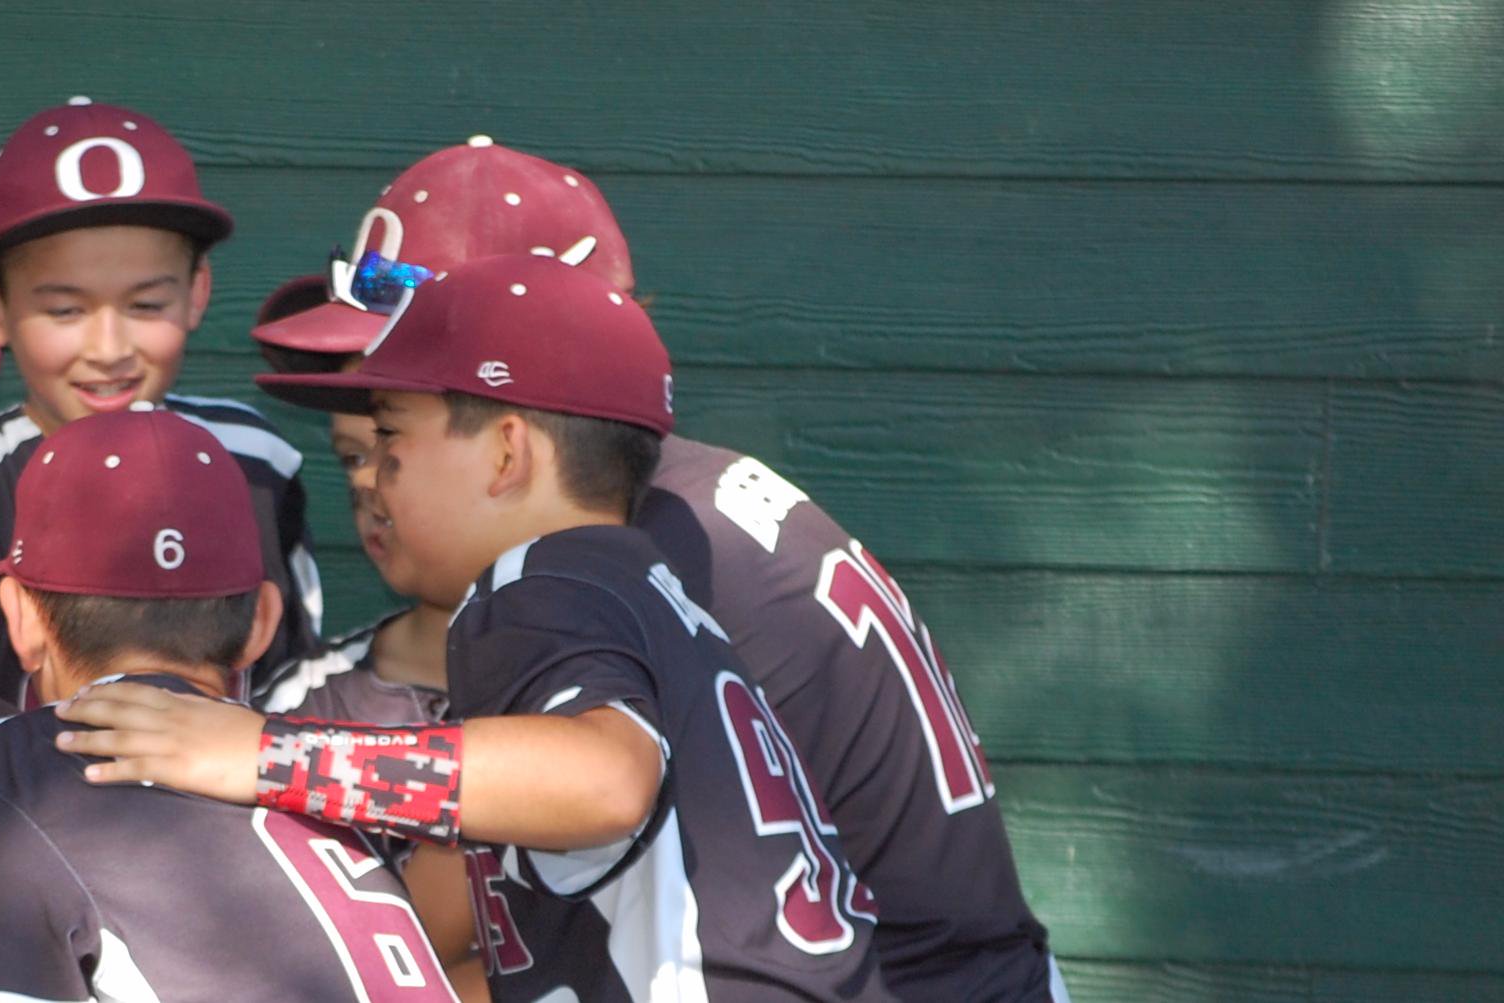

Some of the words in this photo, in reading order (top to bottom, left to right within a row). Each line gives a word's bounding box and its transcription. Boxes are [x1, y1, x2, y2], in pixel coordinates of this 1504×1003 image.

[55, 136, 145, 201] O
[153, 528, 185, 570] 6
[251, 807, 463, 1003] 6
